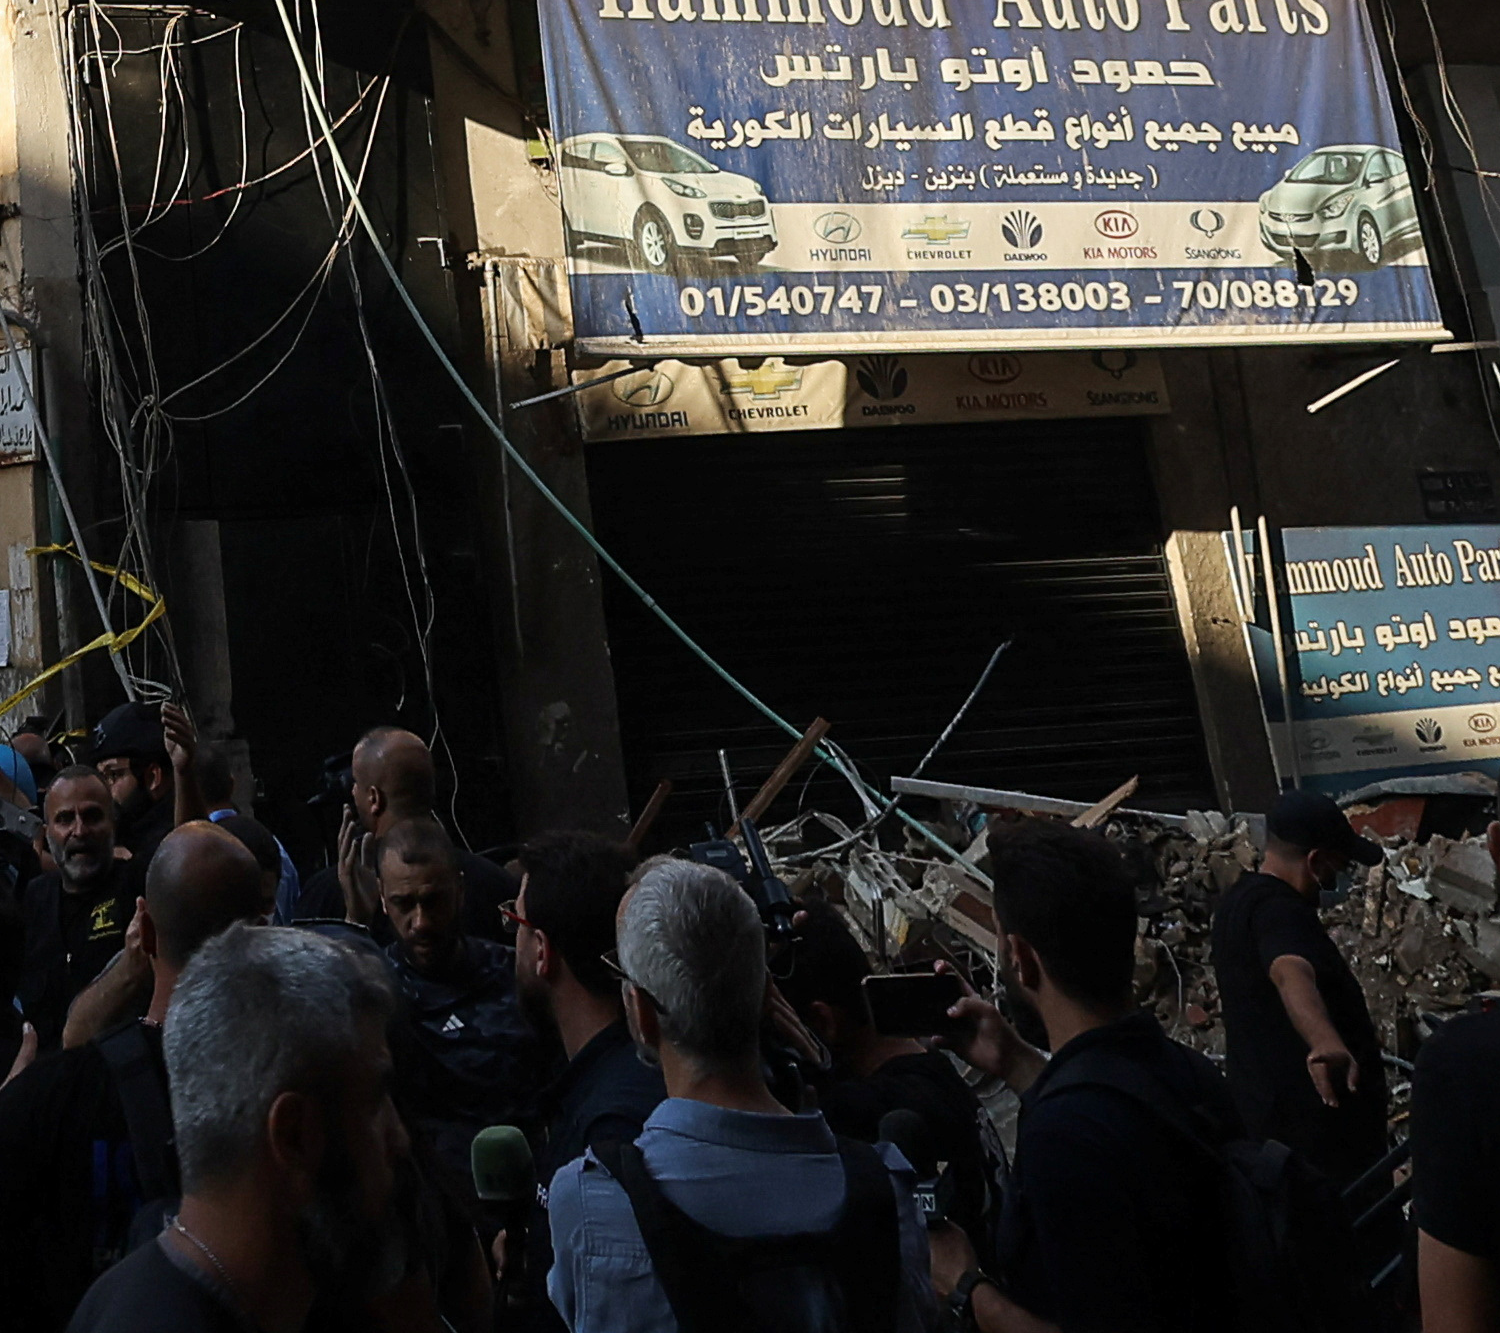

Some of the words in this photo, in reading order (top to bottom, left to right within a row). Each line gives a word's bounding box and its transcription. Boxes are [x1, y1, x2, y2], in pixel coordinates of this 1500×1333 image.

[759, 43, 919, 91] بارتس
[1070, 58, 1216, 93] حمود
[686, 104, 813, 151] الكورية
[821, 111, 975, 152] السيارات
[983, 107, 1056, 151] قطع
[1064, 105, 1135, 151] أنواع
[1143, 117, 1223, 153] جميع
[1230, 119, 1300, 154] مبيع
[861, 164, 906, 191] ديزل
[924, 164, 976, 192] بنزين
[1102, 217, 1133, 233] KIA
[809, 248, 872, 262] HYUNDAI
[906, 249, 972, 260] CHEVROLET
[1003, 252, 1048, 262] DAEWOO
[1083, 246, 1104, 260] KIA
[1106, 245, 1158, 260] MOTORS
[679, 284, 884, 319] 01/540747
[930, 282, 1131, 315] 03/138003
[1172, 279, 1358, 310] 70/088129
[728, 405, 809, 421] CHEVROLET
[956, 394, 980, 410] KIA
[984, 391, 1048, 409] MOTORS
[607, 410, 689, 431] HYUNDAI
[1246, 542, 1384, 596] mmoud
[1394, 541, 1455, 588] Auto
[1376, 660, 1425, 697] أنواع
[1430, 666, 1483, 692] جميع
